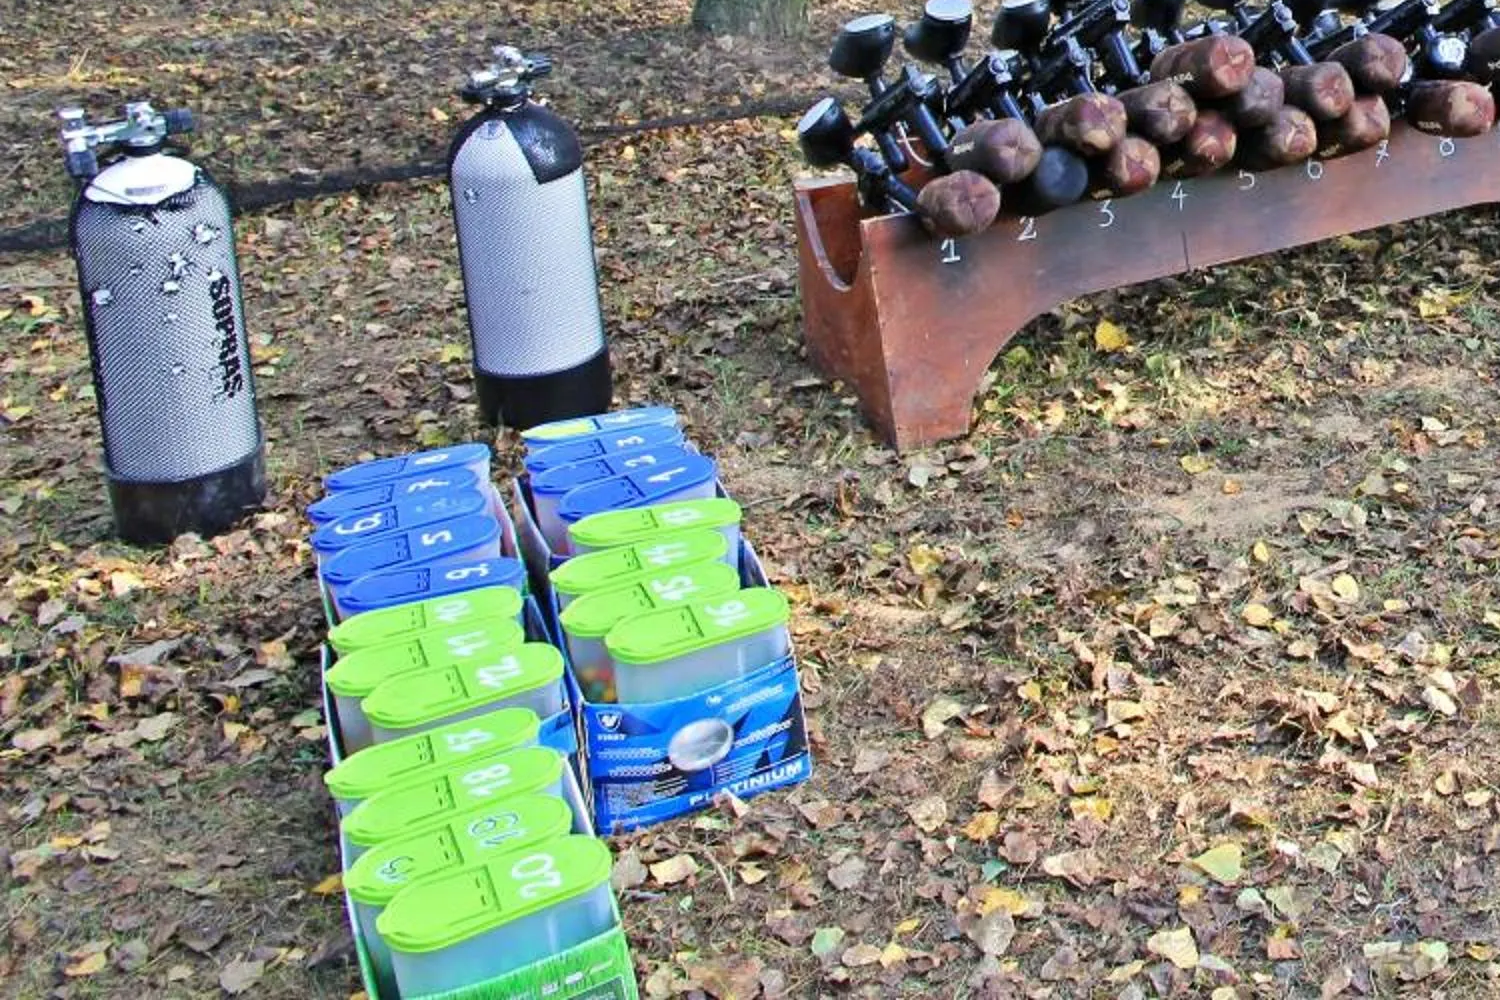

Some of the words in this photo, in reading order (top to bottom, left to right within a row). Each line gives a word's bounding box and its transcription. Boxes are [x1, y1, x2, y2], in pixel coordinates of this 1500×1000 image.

[940, 238, 961, 263] 1
[1016, 216, 1037, 241] 2
[1099, 199, 1115, 228] 3
[1171, 180, 1188, 211] 4
[1238, 169, 1255, 190] 5
[1307, 158, 1323, 180] 6
[1375, 139, 1390, 167] 7
[208, 275, 243, 399] SOPRAS
[421, 530, 453, 546] 5
[476, 655, 521, 688] 12
[461, 763, 513, 797] 18
[510, 852, 563, 899] 20
